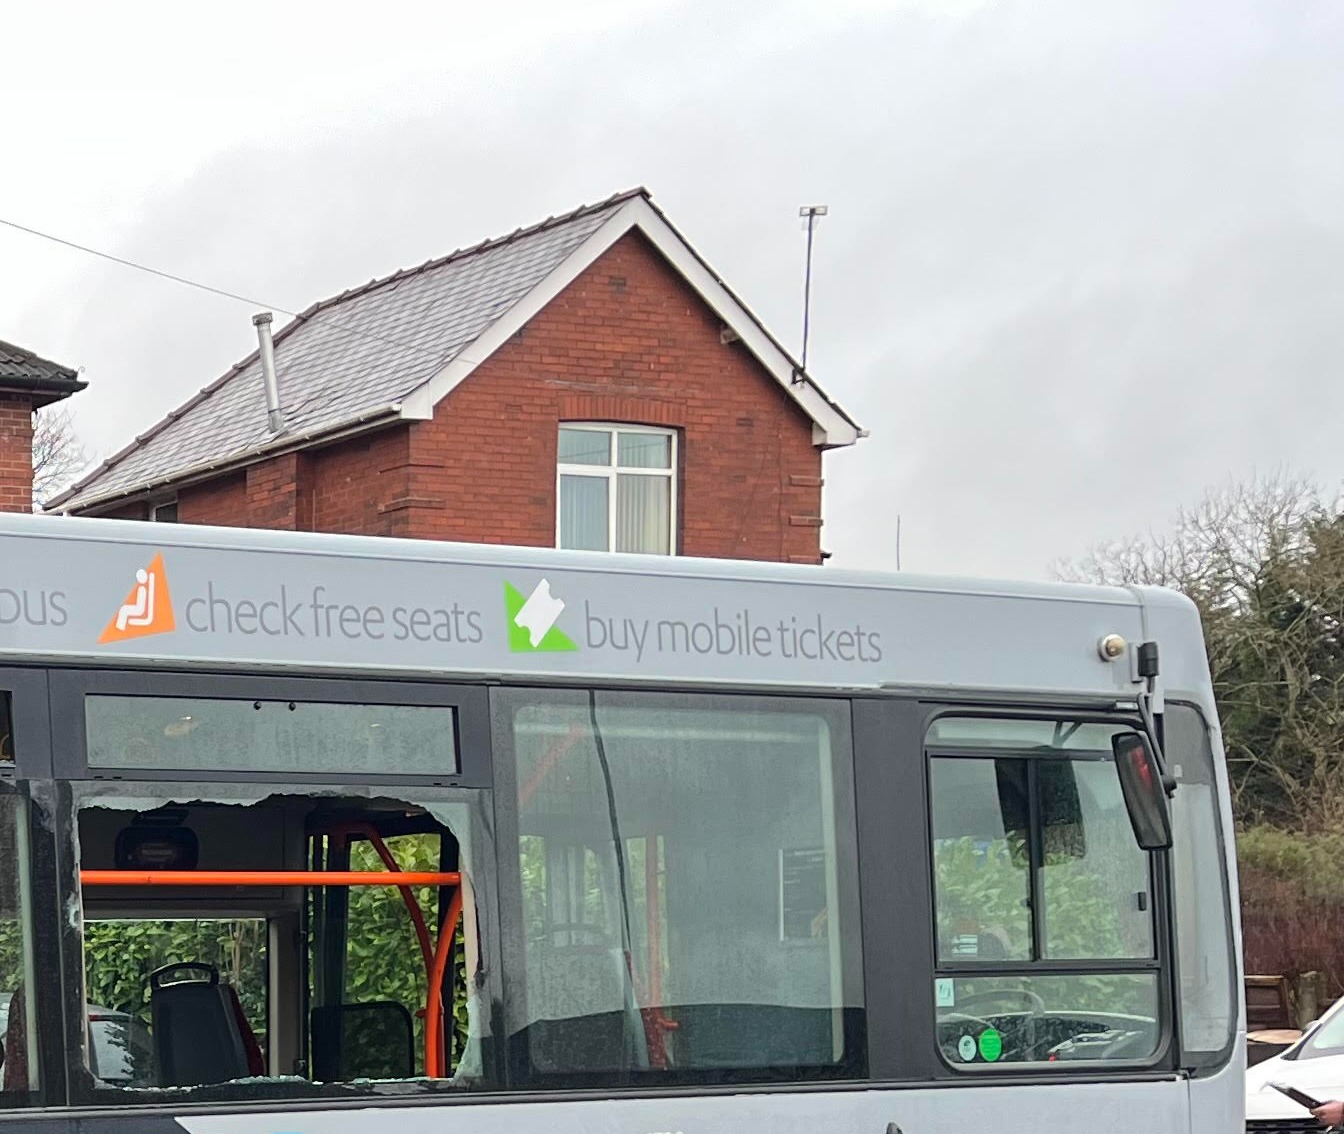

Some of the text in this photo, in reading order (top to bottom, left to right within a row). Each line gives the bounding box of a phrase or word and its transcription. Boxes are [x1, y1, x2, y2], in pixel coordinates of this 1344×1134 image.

[185, 581, 483, 644] check free seats
[584, 599, 882, 663] buy mobile tickets
